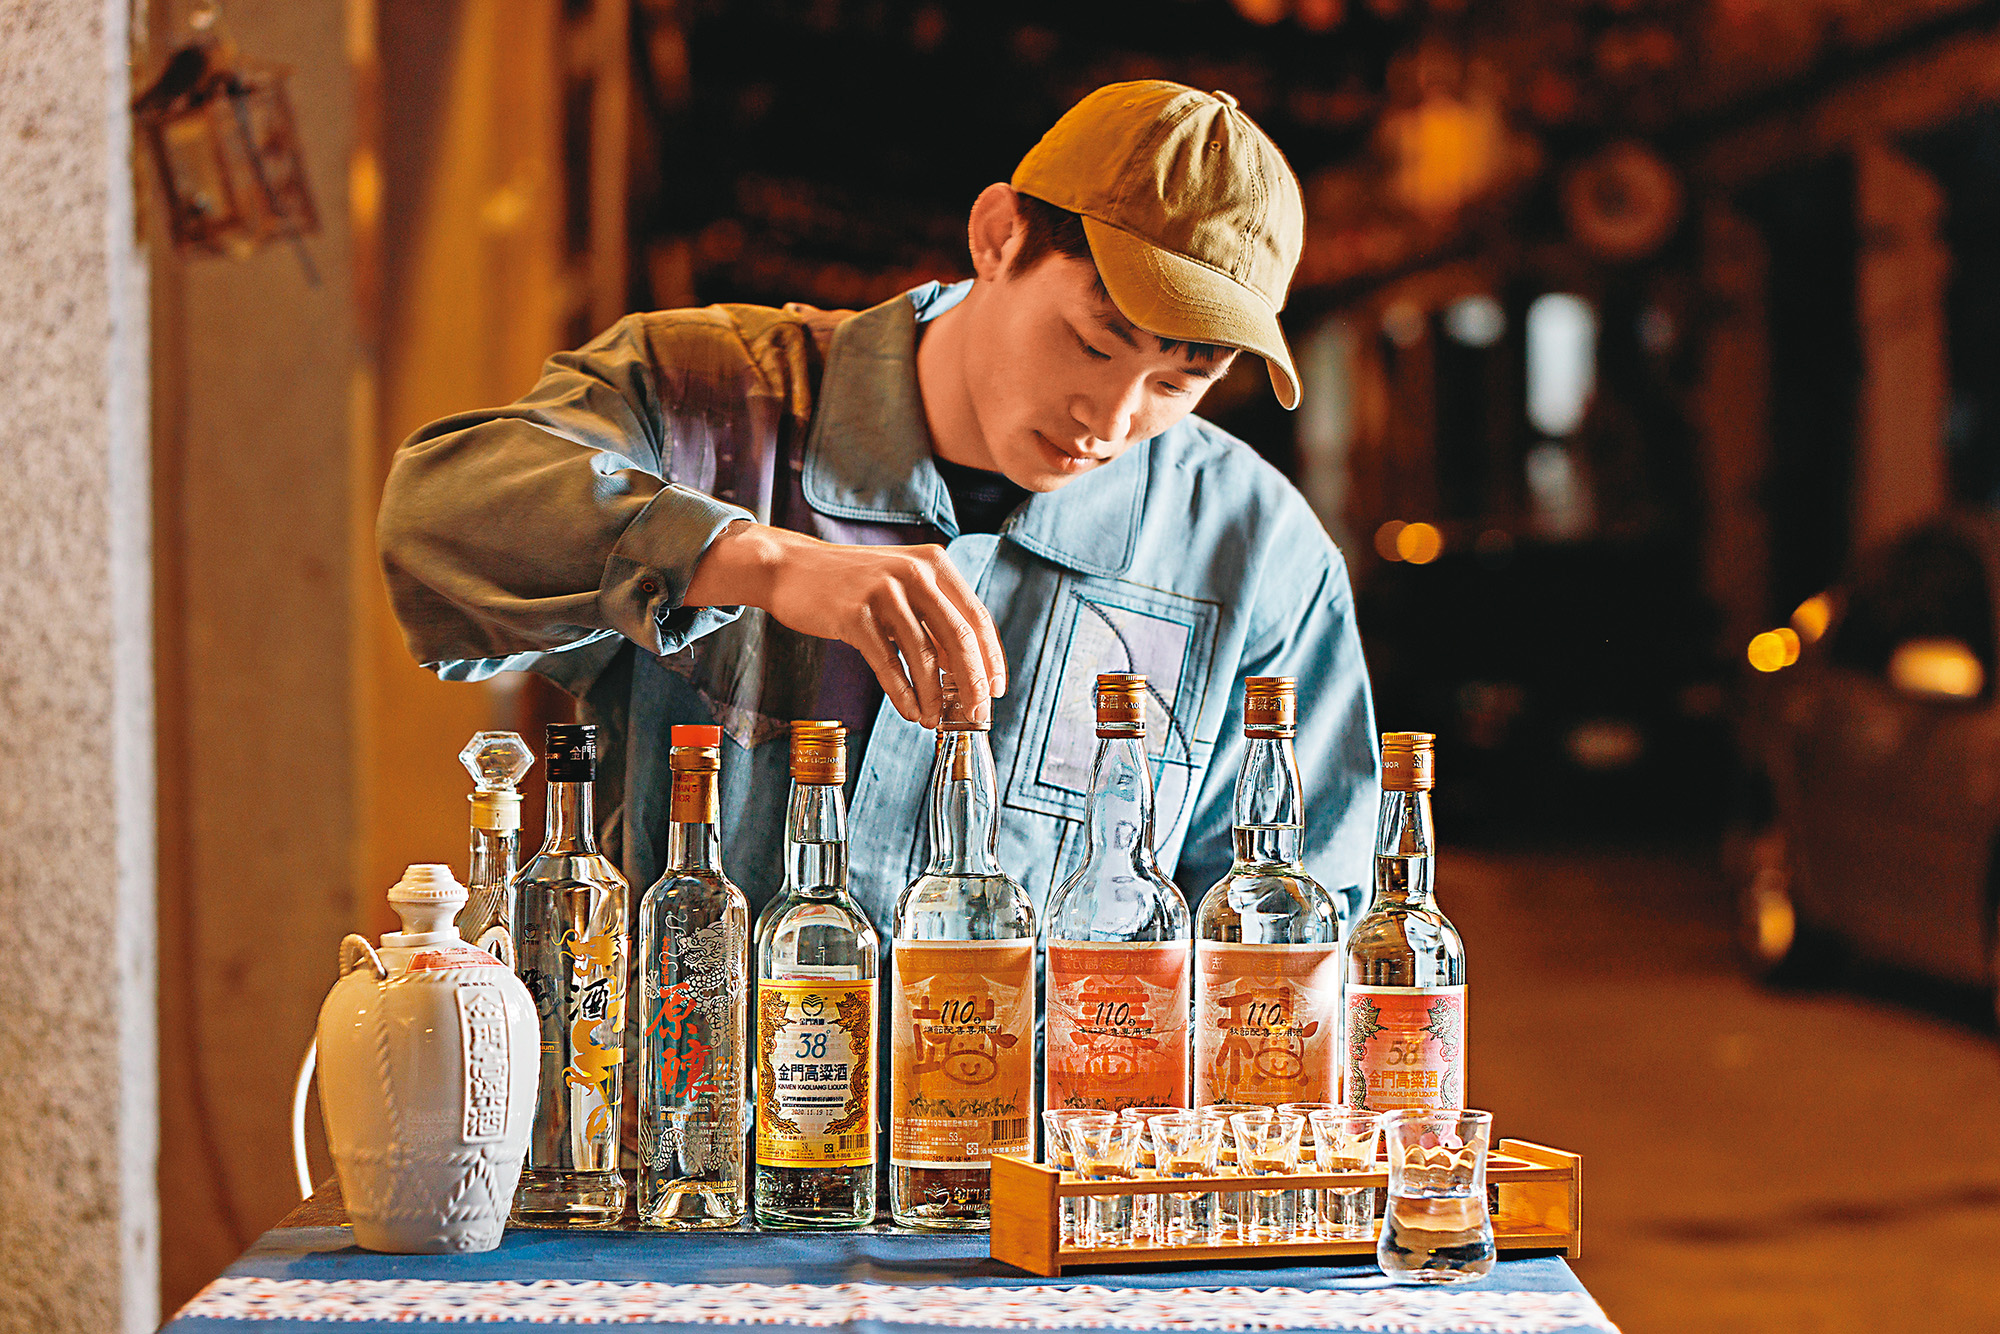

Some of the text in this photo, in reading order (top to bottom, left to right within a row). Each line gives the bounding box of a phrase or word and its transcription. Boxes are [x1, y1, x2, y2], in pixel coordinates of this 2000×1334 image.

[777, 1063, 848, 1082] 金門高粱酒
[1368, 1070, 1438, 1089] 金門高粱酒
[797, 1083, 827, 1091] KAOLIANG
